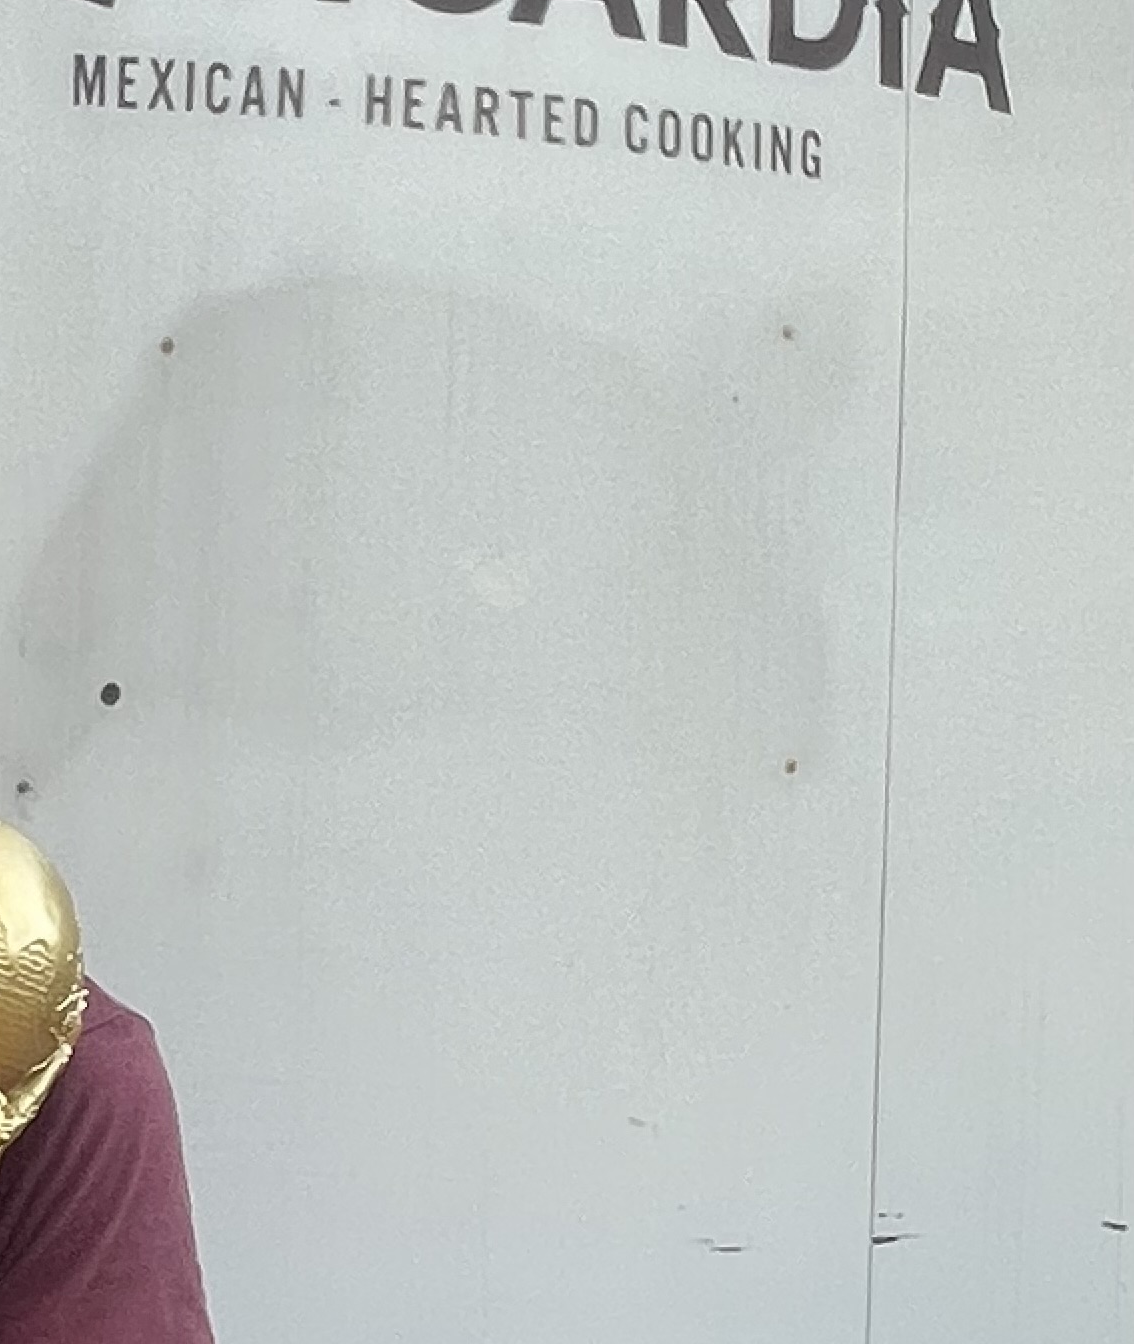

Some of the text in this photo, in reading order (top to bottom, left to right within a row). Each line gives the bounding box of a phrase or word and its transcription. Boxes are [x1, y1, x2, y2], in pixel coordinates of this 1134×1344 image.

[72, 53, 305, 119] MEXICAN
[365, 73, 599, 148] HEARTED
[624, 103, 823, 180] COOKING
